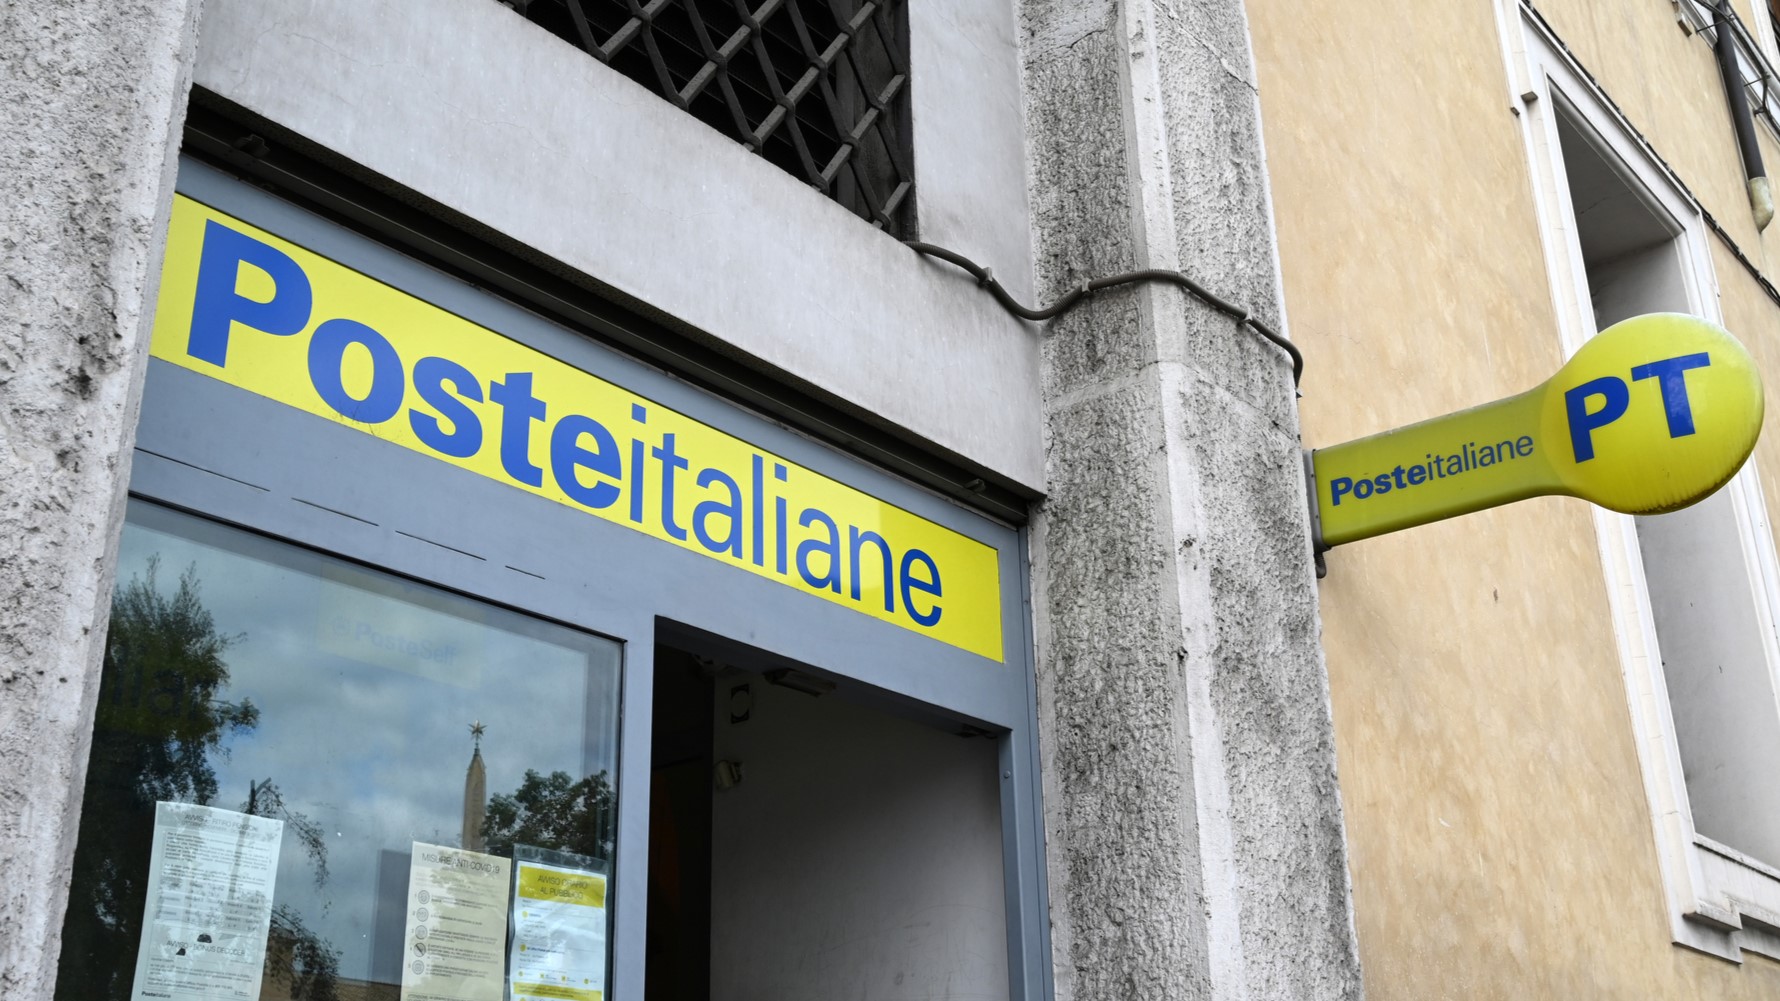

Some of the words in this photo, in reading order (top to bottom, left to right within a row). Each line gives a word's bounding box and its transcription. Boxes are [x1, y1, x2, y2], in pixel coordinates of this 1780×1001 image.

[187, 218, 943, 627] Posteitaliane
[1564, 351, 1711, 464] PT
[1330, 435, 1534, 506] Posteitaliane
